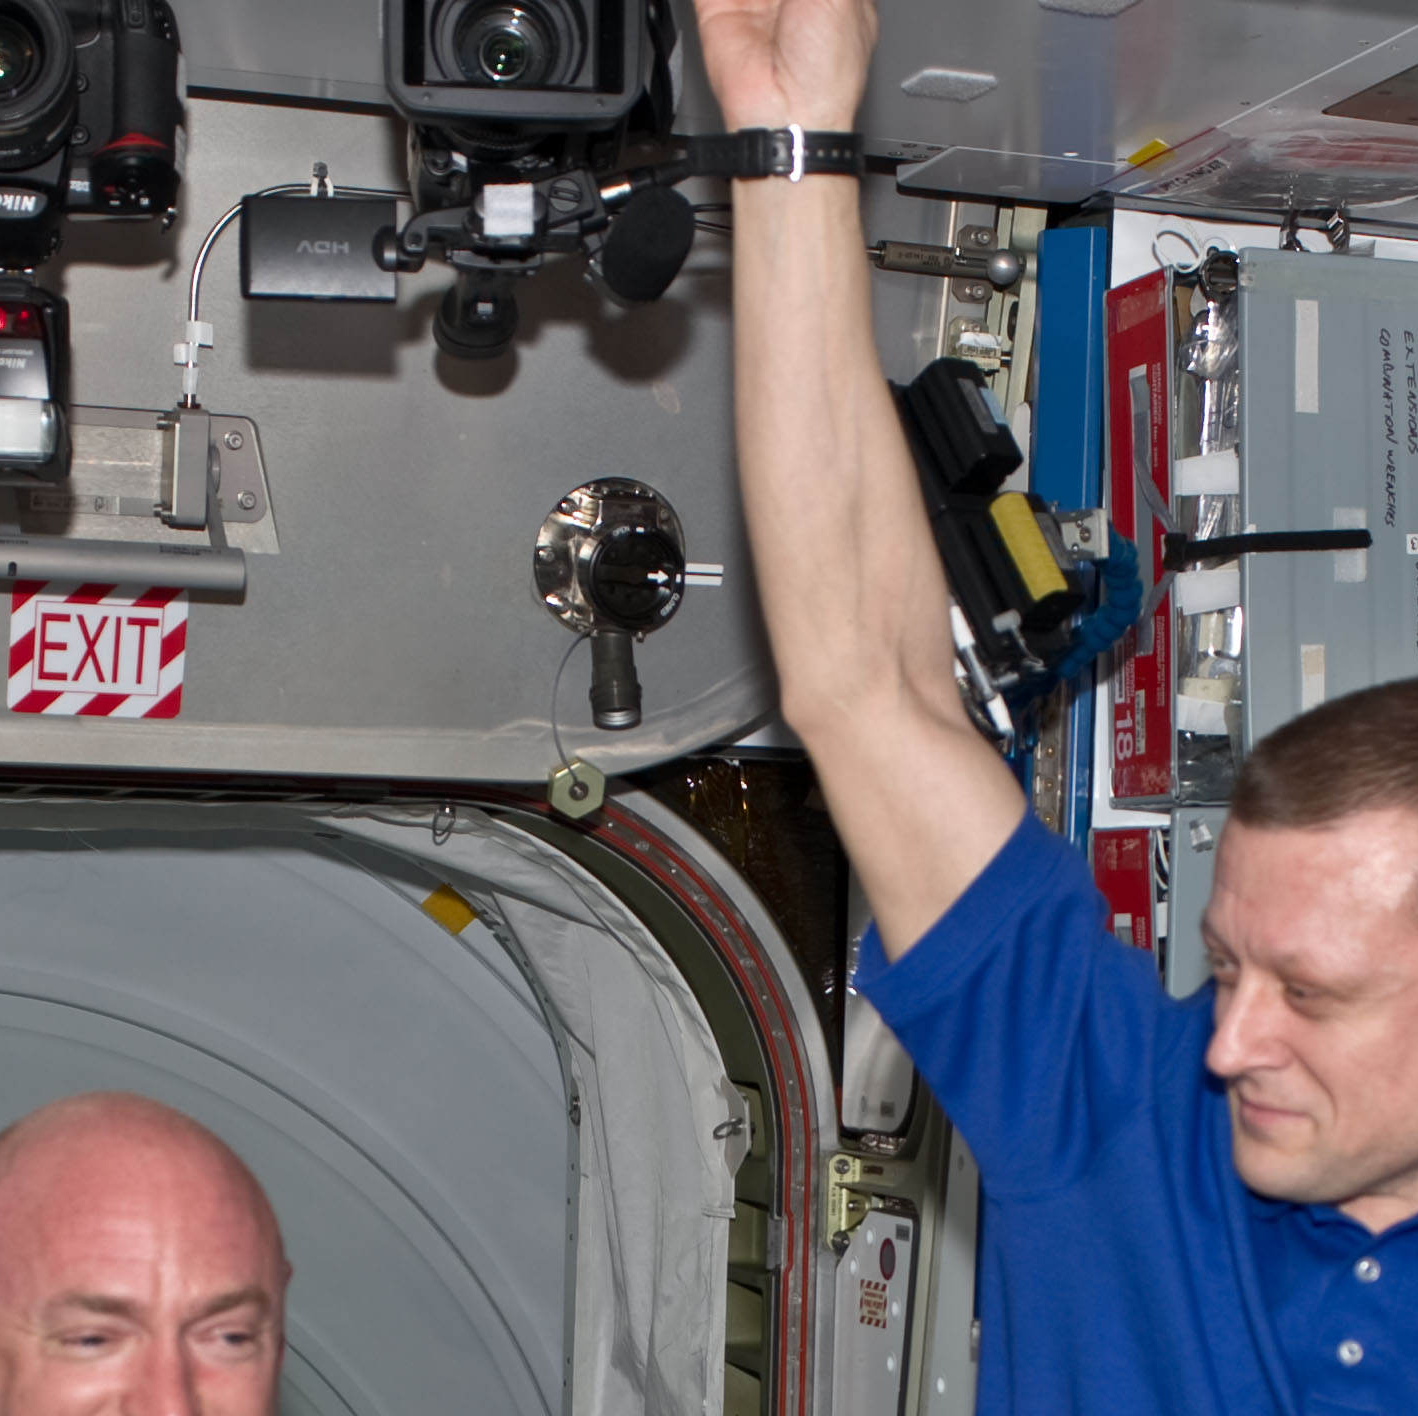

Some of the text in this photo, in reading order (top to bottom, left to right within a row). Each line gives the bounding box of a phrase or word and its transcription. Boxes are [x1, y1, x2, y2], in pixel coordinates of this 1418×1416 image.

[296, 240, 349, 254] HDV
[1404, 330, 1418, 455] EXTENSIONS
[1384, 449, 1396, 527] WRENCHES
[38, 612, 159, 685] EXIT
[1116, 710, 1133, 760] 18
